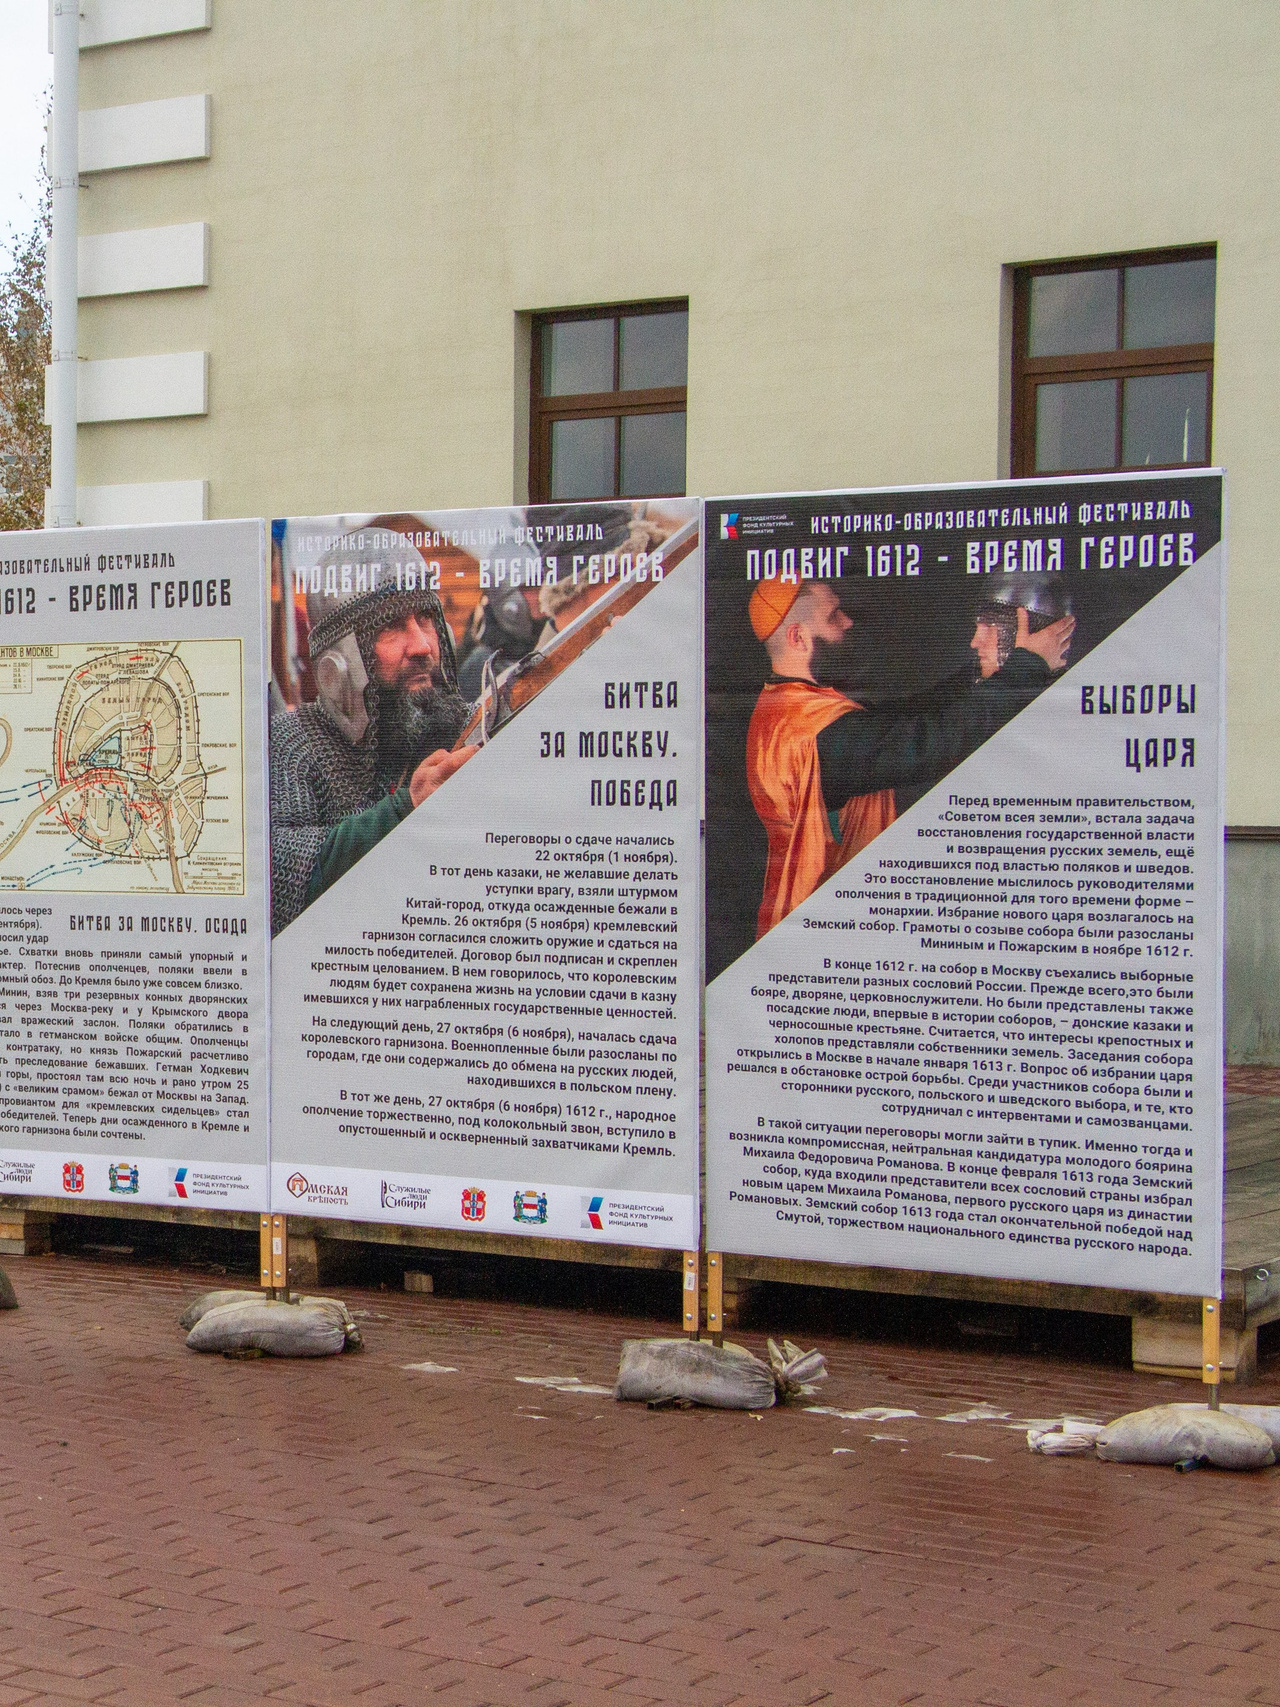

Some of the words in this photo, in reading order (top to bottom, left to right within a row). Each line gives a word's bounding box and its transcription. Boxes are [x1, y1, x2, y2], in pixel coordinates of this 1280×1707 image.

[810, 506, 1067, 532] ИСТОРИКО-ОБРАЗОВАТЕЛЬНЫЙ
[1078, 500, 1190, 524] ФЕСТИВАЛЬ
[97, 552, 174, 572] ФЕСТИВАЛЬ
[746, 547, 848, 585] ПОДВИГ
[865, 544, 919, 576] 1612
[966, 538, 1061, 576] ВРЕМЯ
[1080, 533, 1197, 569] ГЕРОЕВ
[294, 564, 382, 598] ПОДВИГ
[396, 561, 441, 592] 1612
[479, 556, 558, 588] ВРЕМЯ
[572, 551, 665, 584] ГЕРОЕВ
[69, 583, 137, 611] ВРЕМЯ
[150, 579, 230, 608] ГЕРОЕВ
[604, 681, 677, 708] БИТВА
[1081, 684, 1195, 714] ВЫБОРЫ
[540, 731, 564, 758] ЗА
[578, 730, 676, 757] МОСКВУ.
[1125, 738, 1194, 771] ЦАРЯ
[590, 779, 677, 810] ПОБЕДА
[948, 794, 989, 808] Перед
[992, 797, 1072, 808] временным
[1075, 798, 1194, 808] правительством,
[938, 810, 1001, 822] «Советом
[1004, 813, 1035, 822] всея
[1039, 814, 1091, 824] земли»,
[1095, 814, 1142, 823] встала
[1146, 815, 1194, 825] задача
[485, 832, 560, 846] Переговоры
[564, 835, 572, 844] о
[575, 835, 612, 846] сдаче
[615, 836, 674, 845] начались
[535, 849, 549, 861] 22
[553, 850, 604, 864] октября
[608, 850, 618, 864] (1
[623, 851, 677, 865] ноября).
[25, 907, 52, 916] через
[69, 915, 110, 930] БИТВА
[118, 915, 132, 931] ЗА
[140, 916, 196, 932] МОСКВУ.
[205, 917, 246, 935] ОСАДА
[21, 1126, 70, 1135] гарнизона
[72, 1126, 98, 1137] были
[100, 1130, 145, 1140] сочтены.
[338, 1124, 426, 1138] опустошенный
[429, 1131, 436, 1139] и
[439, 1132, 528, 1145] оскверненный
[532, 1138, 619, 1152] захватчиками
[622, 1142, 675, 1156] Кремль.
[775, 1210, 824, 1225] Смутой,
[827, 1216, 904, 1230] торжеством
[907, 1224, 1005, 1239] национального
[1008, 1232, 1070, 1245] единства
[1074, 1238, 1134, 1251] русского
[1138, 1244, 1191, 1256] народа.
